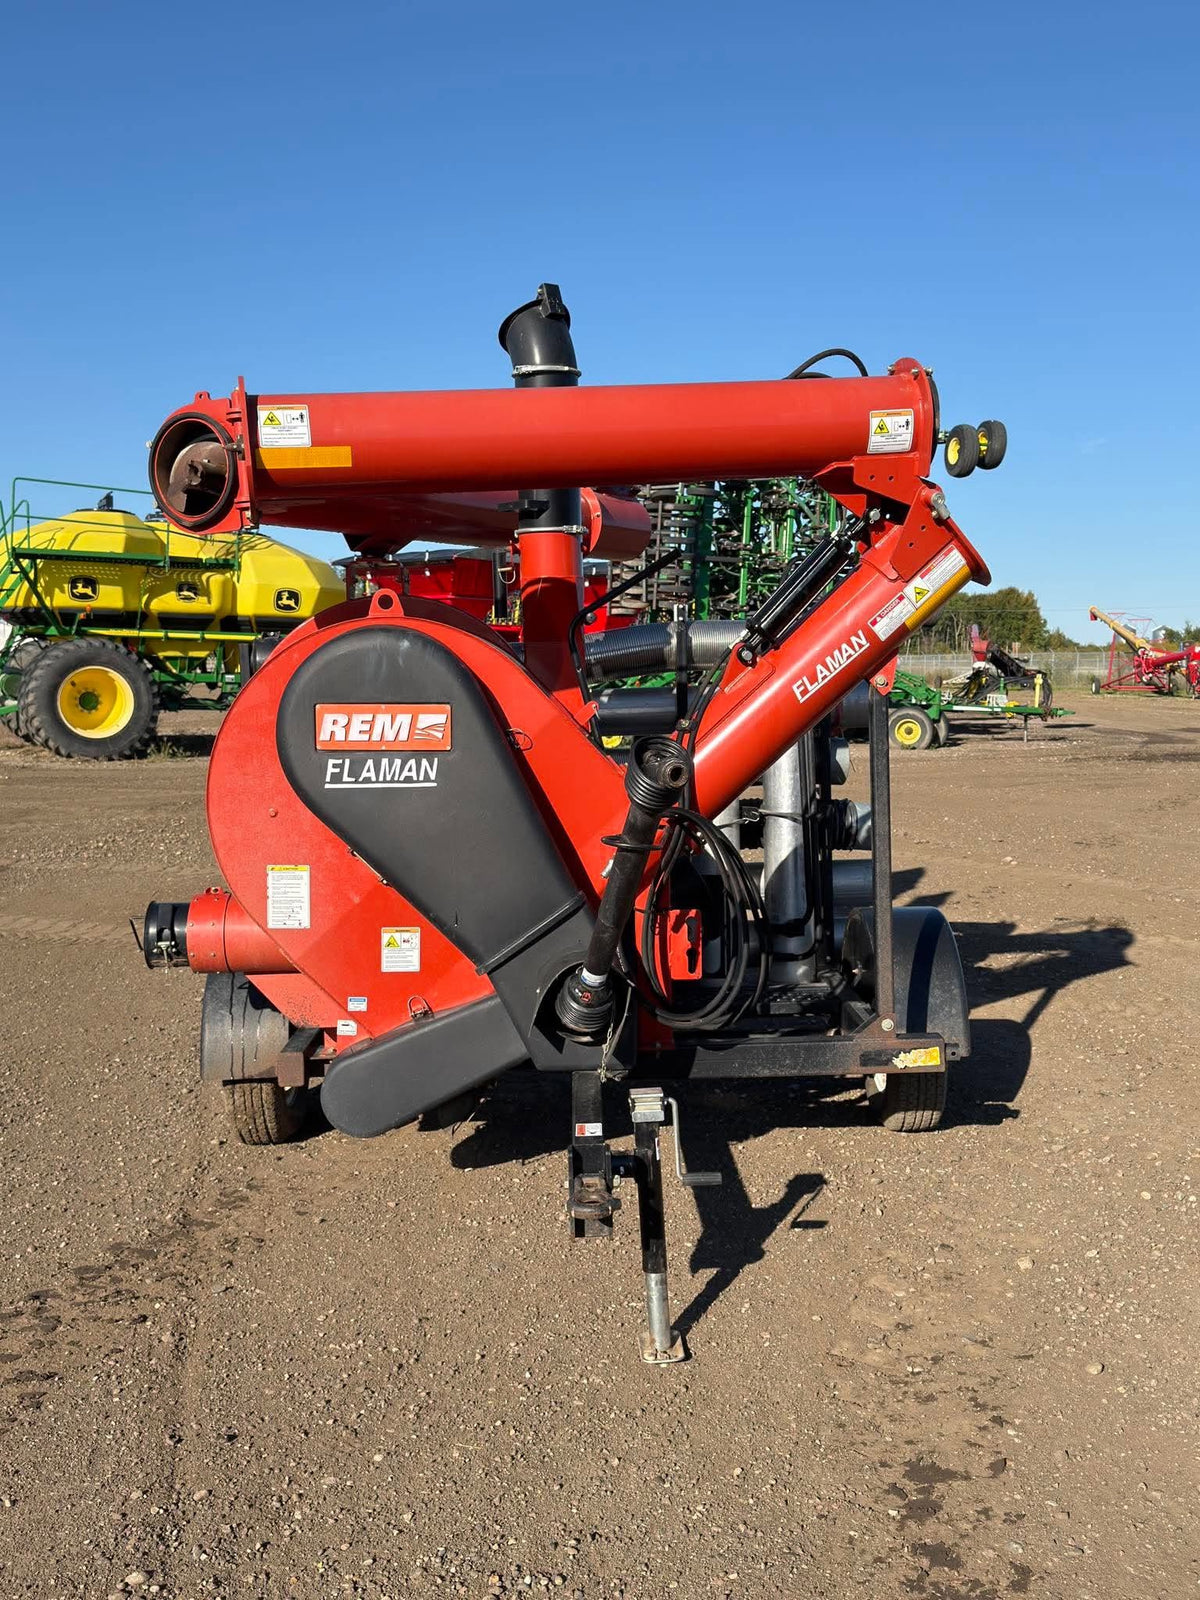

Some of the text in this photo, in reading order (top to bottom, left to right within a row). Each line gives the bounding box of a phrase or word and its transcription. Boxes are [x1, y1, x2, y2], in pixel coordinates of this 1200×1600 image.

[792, 630, 869, 700] FLAMAN
[319, 713, 412, 742] REM
[325, 758, 438, 782] FLAMAN
